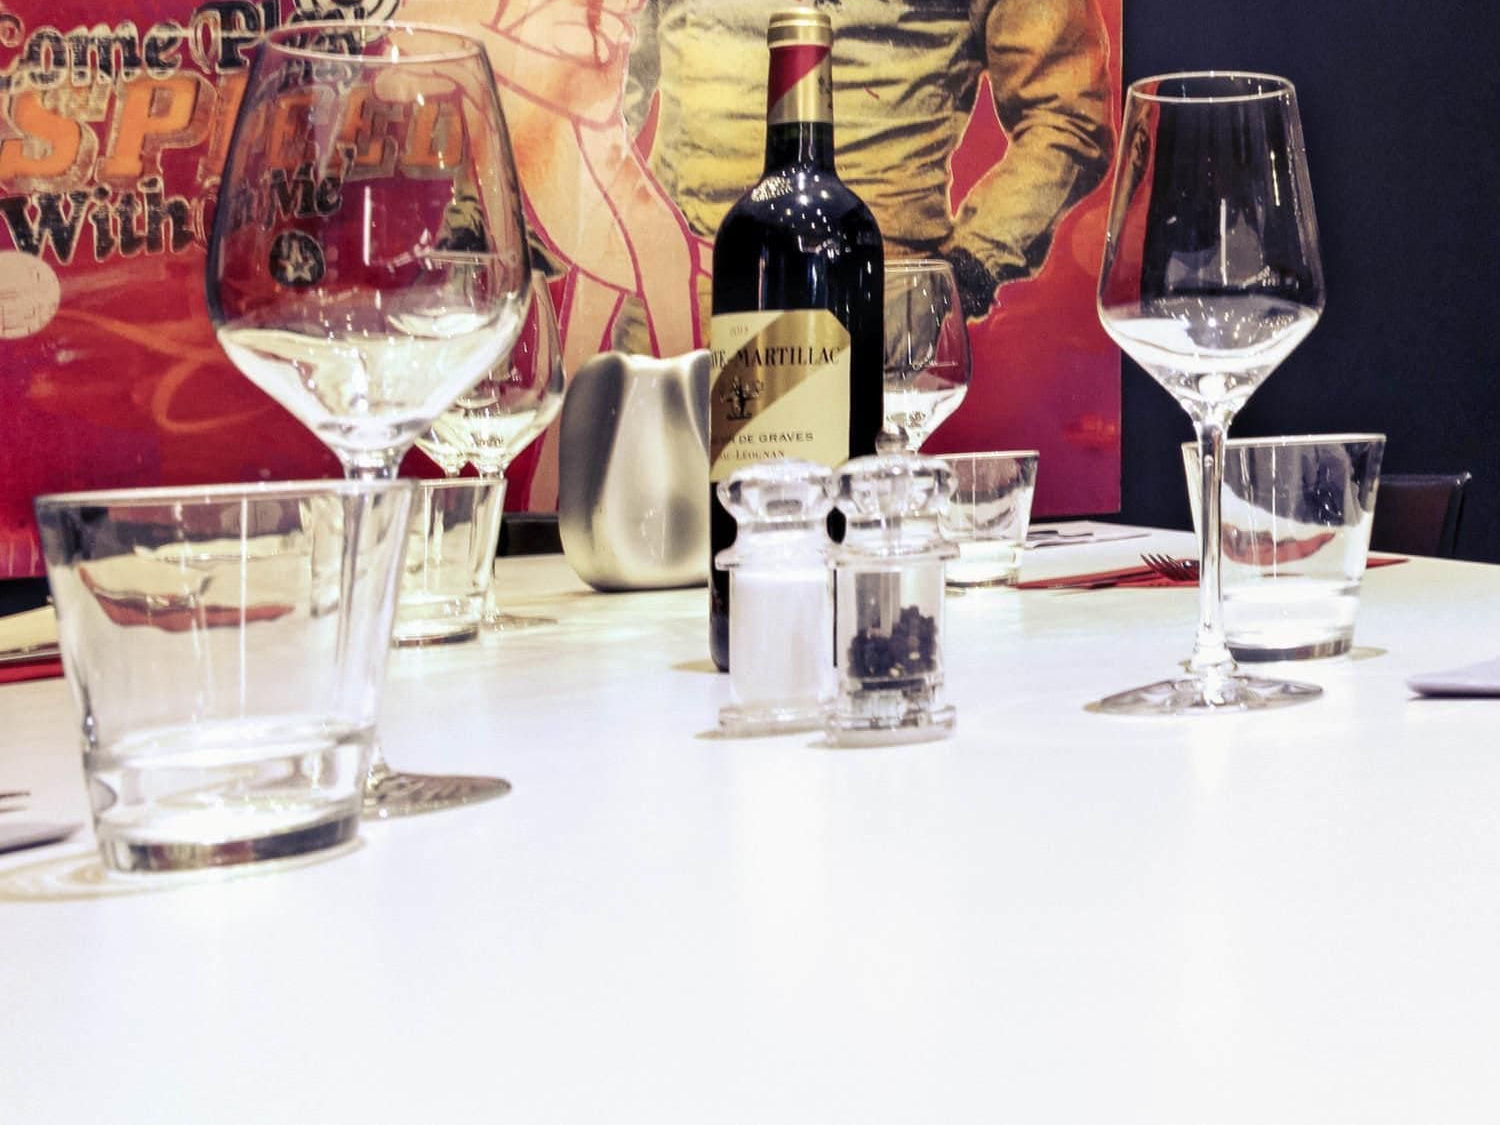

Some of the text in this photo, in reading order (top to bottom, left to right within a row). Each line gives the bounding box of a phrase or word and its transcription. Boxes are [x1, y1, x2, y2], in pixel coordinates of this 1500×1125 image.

[0, 175, 193, 265] With
[737, 347, 840, 368] MARTILLAC
[738, 434, 755, 444] DE
[758, 431, 815, 444] GRAVES
